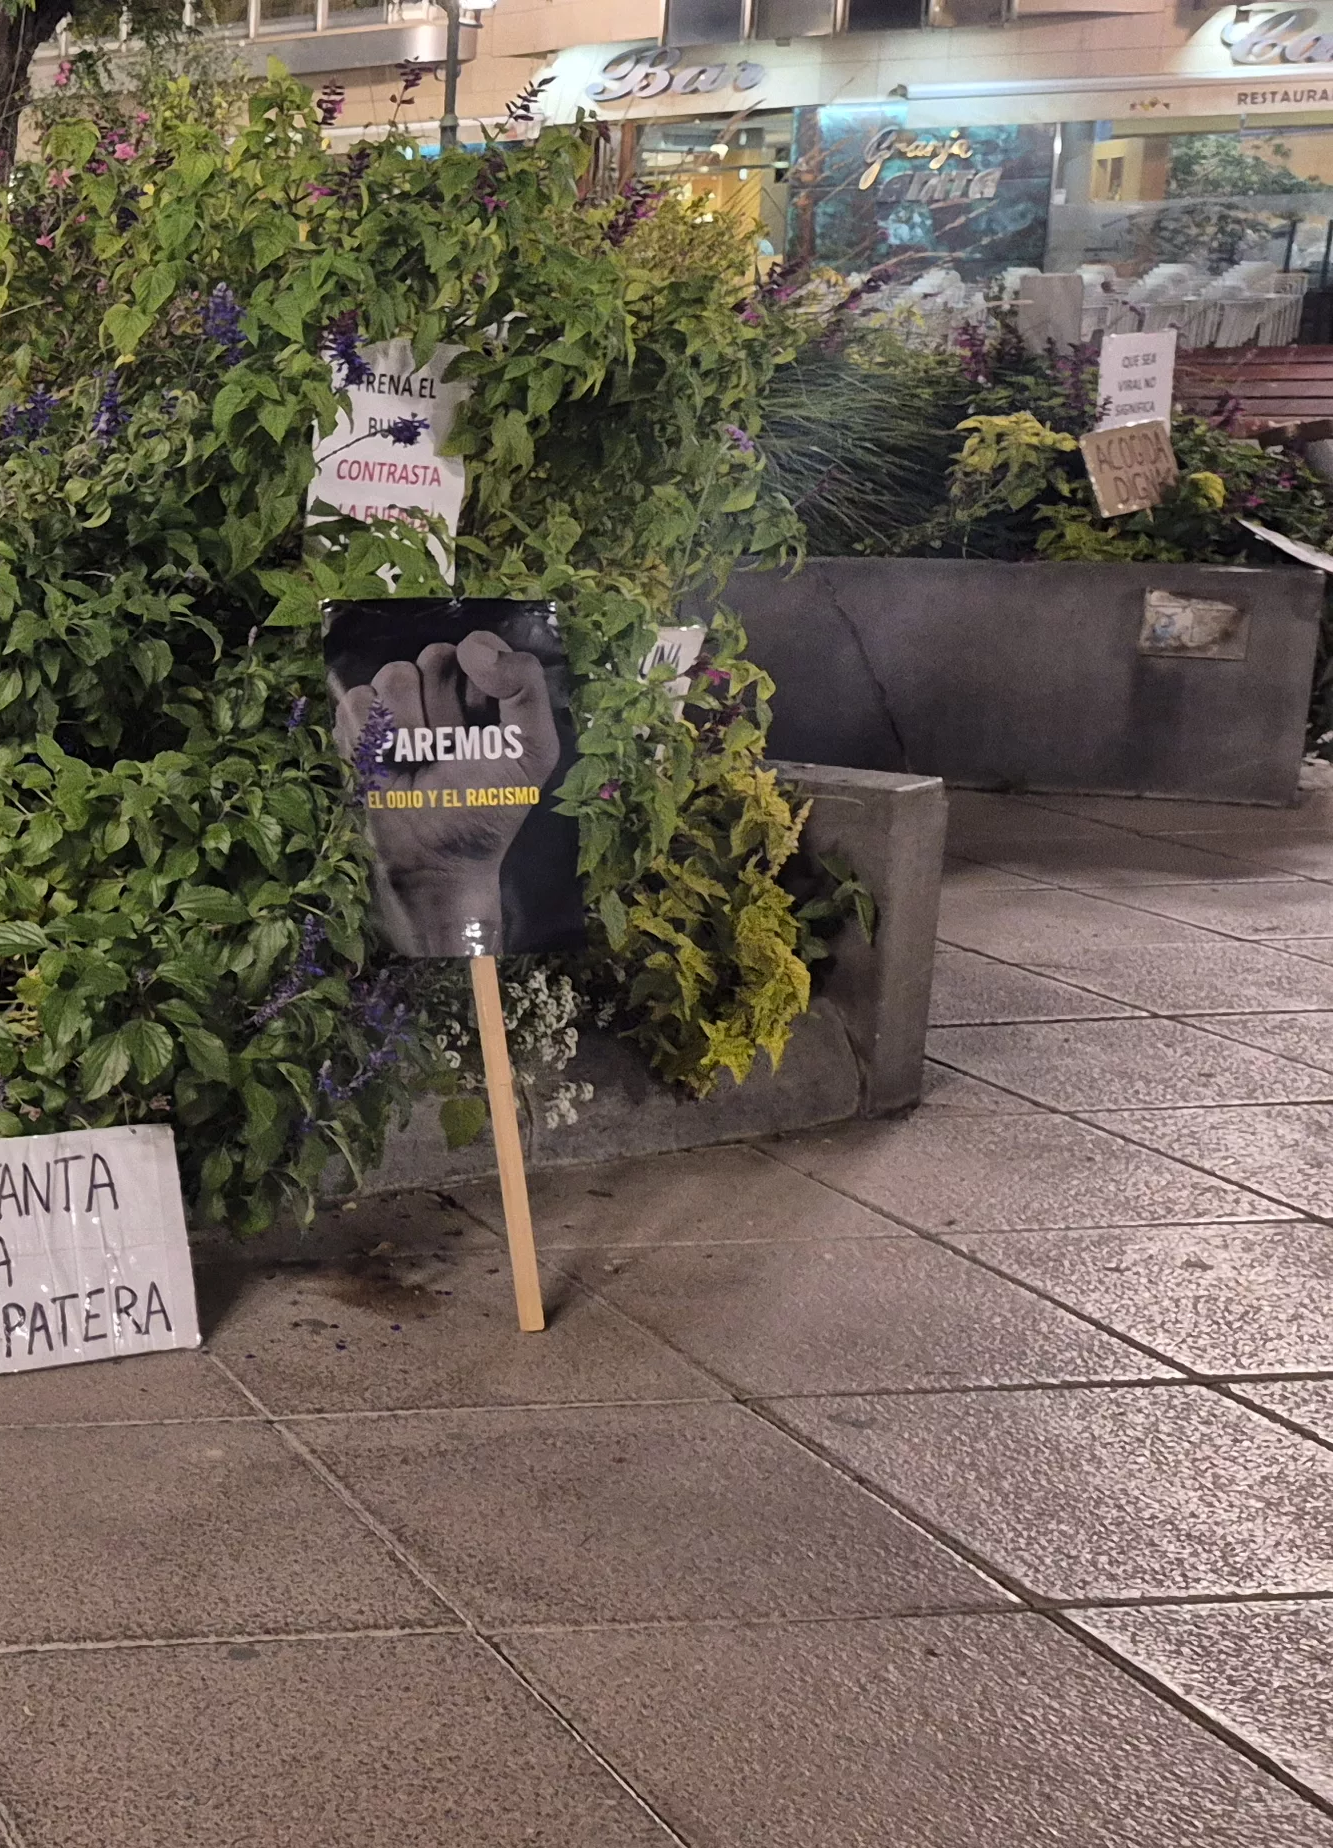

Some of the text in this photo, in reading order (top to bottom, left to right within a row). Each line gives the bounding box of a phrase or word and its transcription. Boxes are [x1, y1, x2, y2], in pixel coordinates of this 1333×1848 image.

[586, 45, 765, 102] Bar
[1236, 88, 1332, 105] RESTAURA
[859, 124, 973, 190] Granja
[419, 377, 437, 400] EL
[336, 458, 442, 488] CONTRASTA
[374, 724, 525, 763] PAREMOS
[367, 786, 541, 809] EL ODIO Y EL RACISMO
[1, 1280, 173, 1358] PATERA
